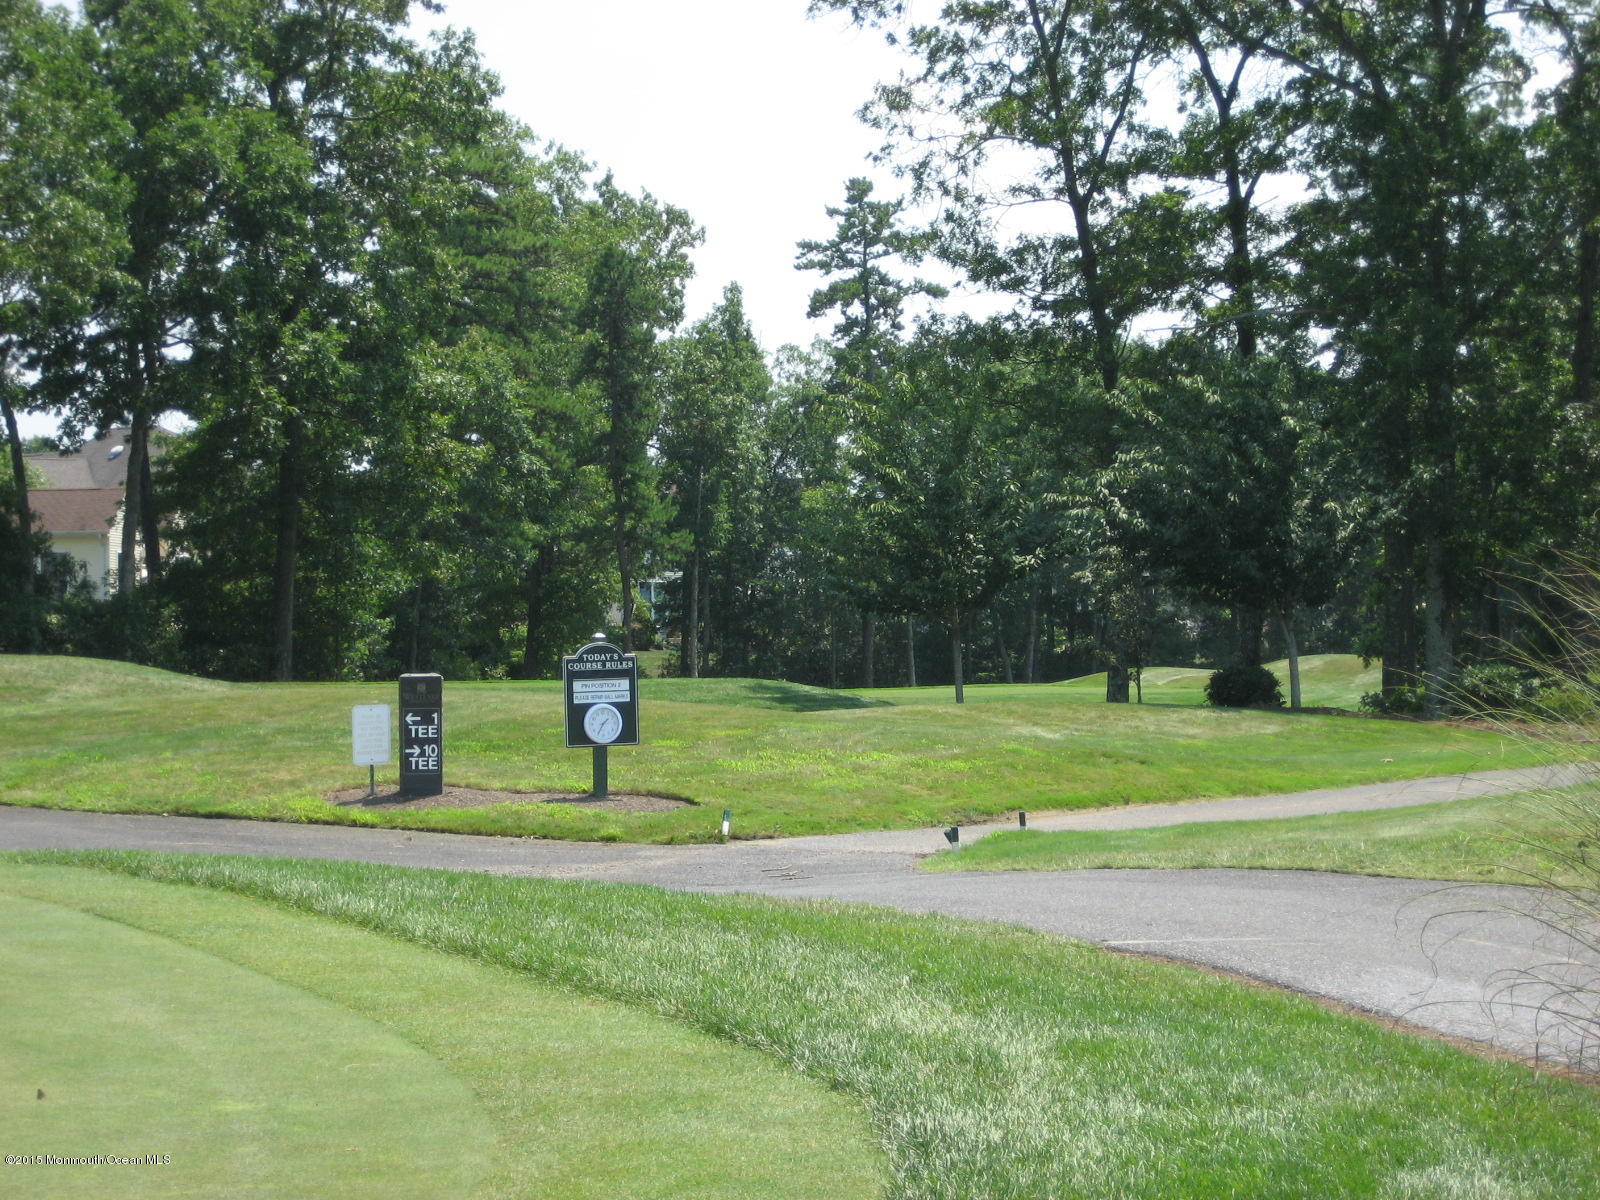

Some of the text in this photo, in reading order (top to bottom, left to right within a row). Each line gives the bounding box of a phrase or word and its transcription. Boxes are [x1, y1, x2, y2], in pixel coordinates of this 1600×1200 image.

[568, 661, 633, 670] COURSE RULES
[431, 712, 438, 725] 1
[408, 725, 438, 738] TEE
[423, 744, 438, 757] 10
[408, 757, 438, 770] TEE
